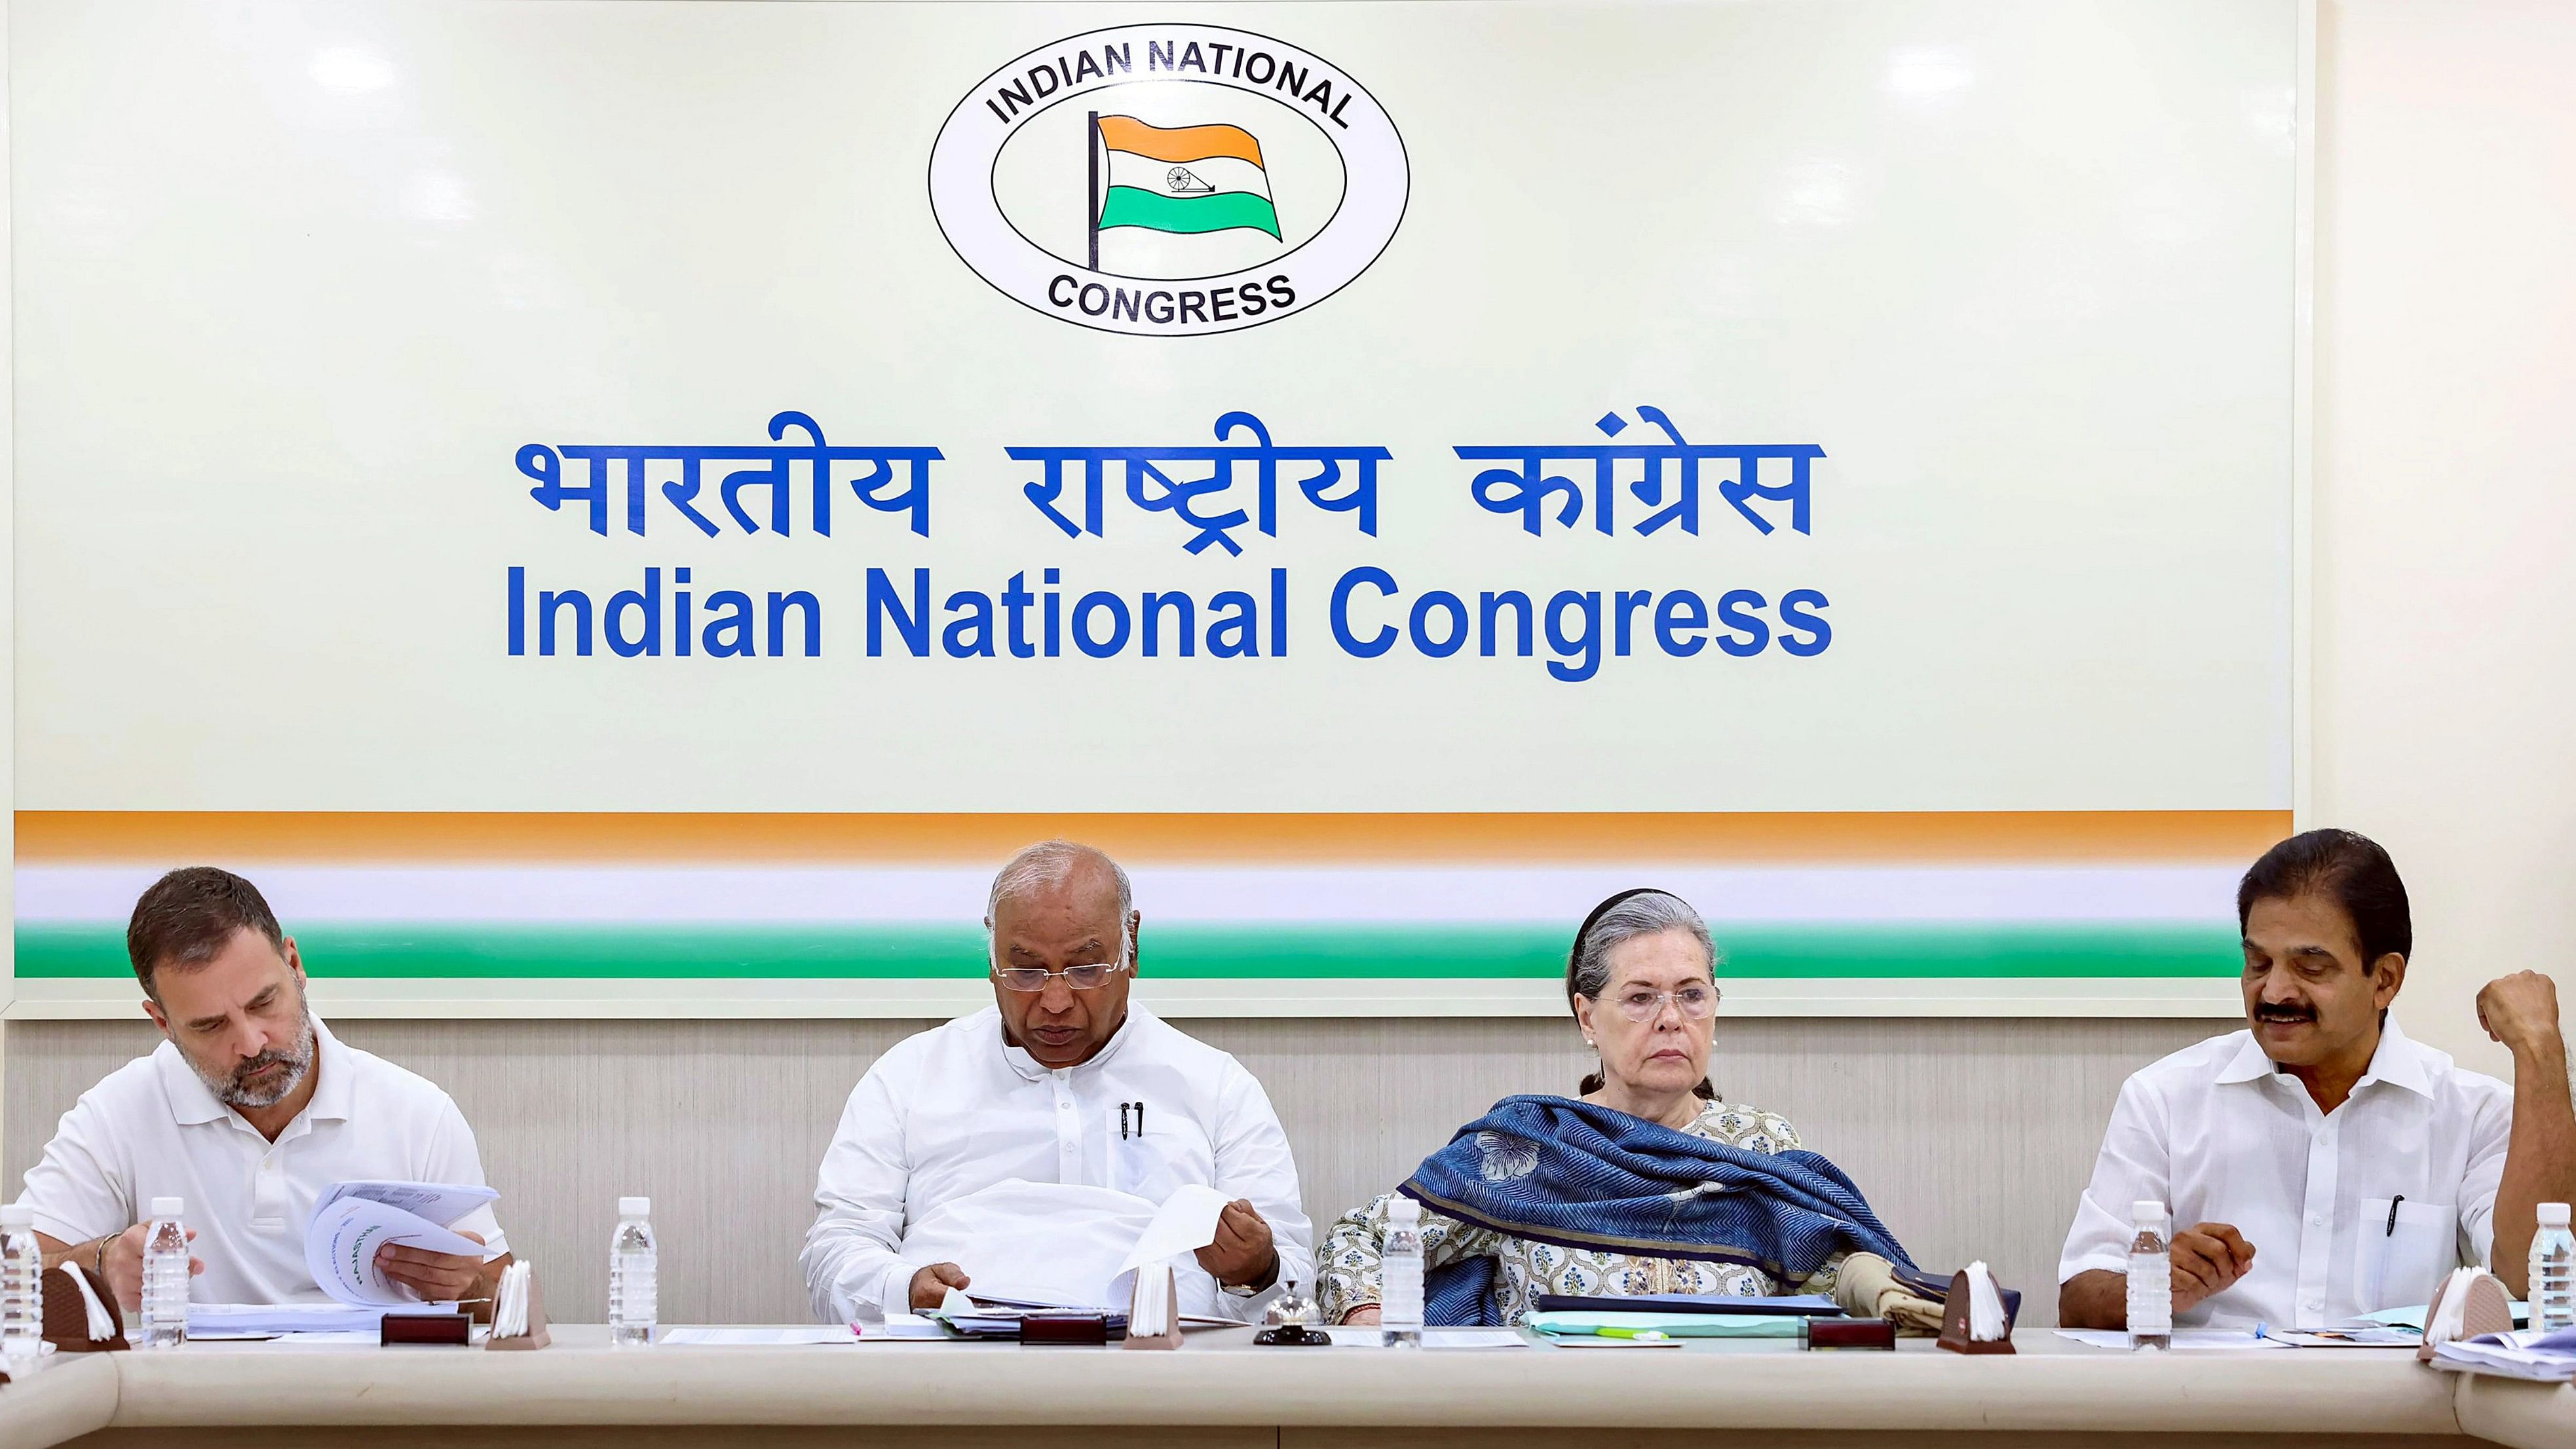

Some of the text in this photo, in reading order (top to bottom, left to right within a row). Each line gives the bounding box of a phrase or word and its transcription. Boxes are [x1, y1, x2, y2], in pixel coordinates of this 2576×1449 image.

[986, 40, 1352, 130] INDIAN NATIONAL
[1048, 274, 1296, 324] CONGRESS
[516, 405, 1827, 555] भारतीय राष्ट्रीय कांग्रेस
[508, 566, 1832, 683] Indian National Congress
